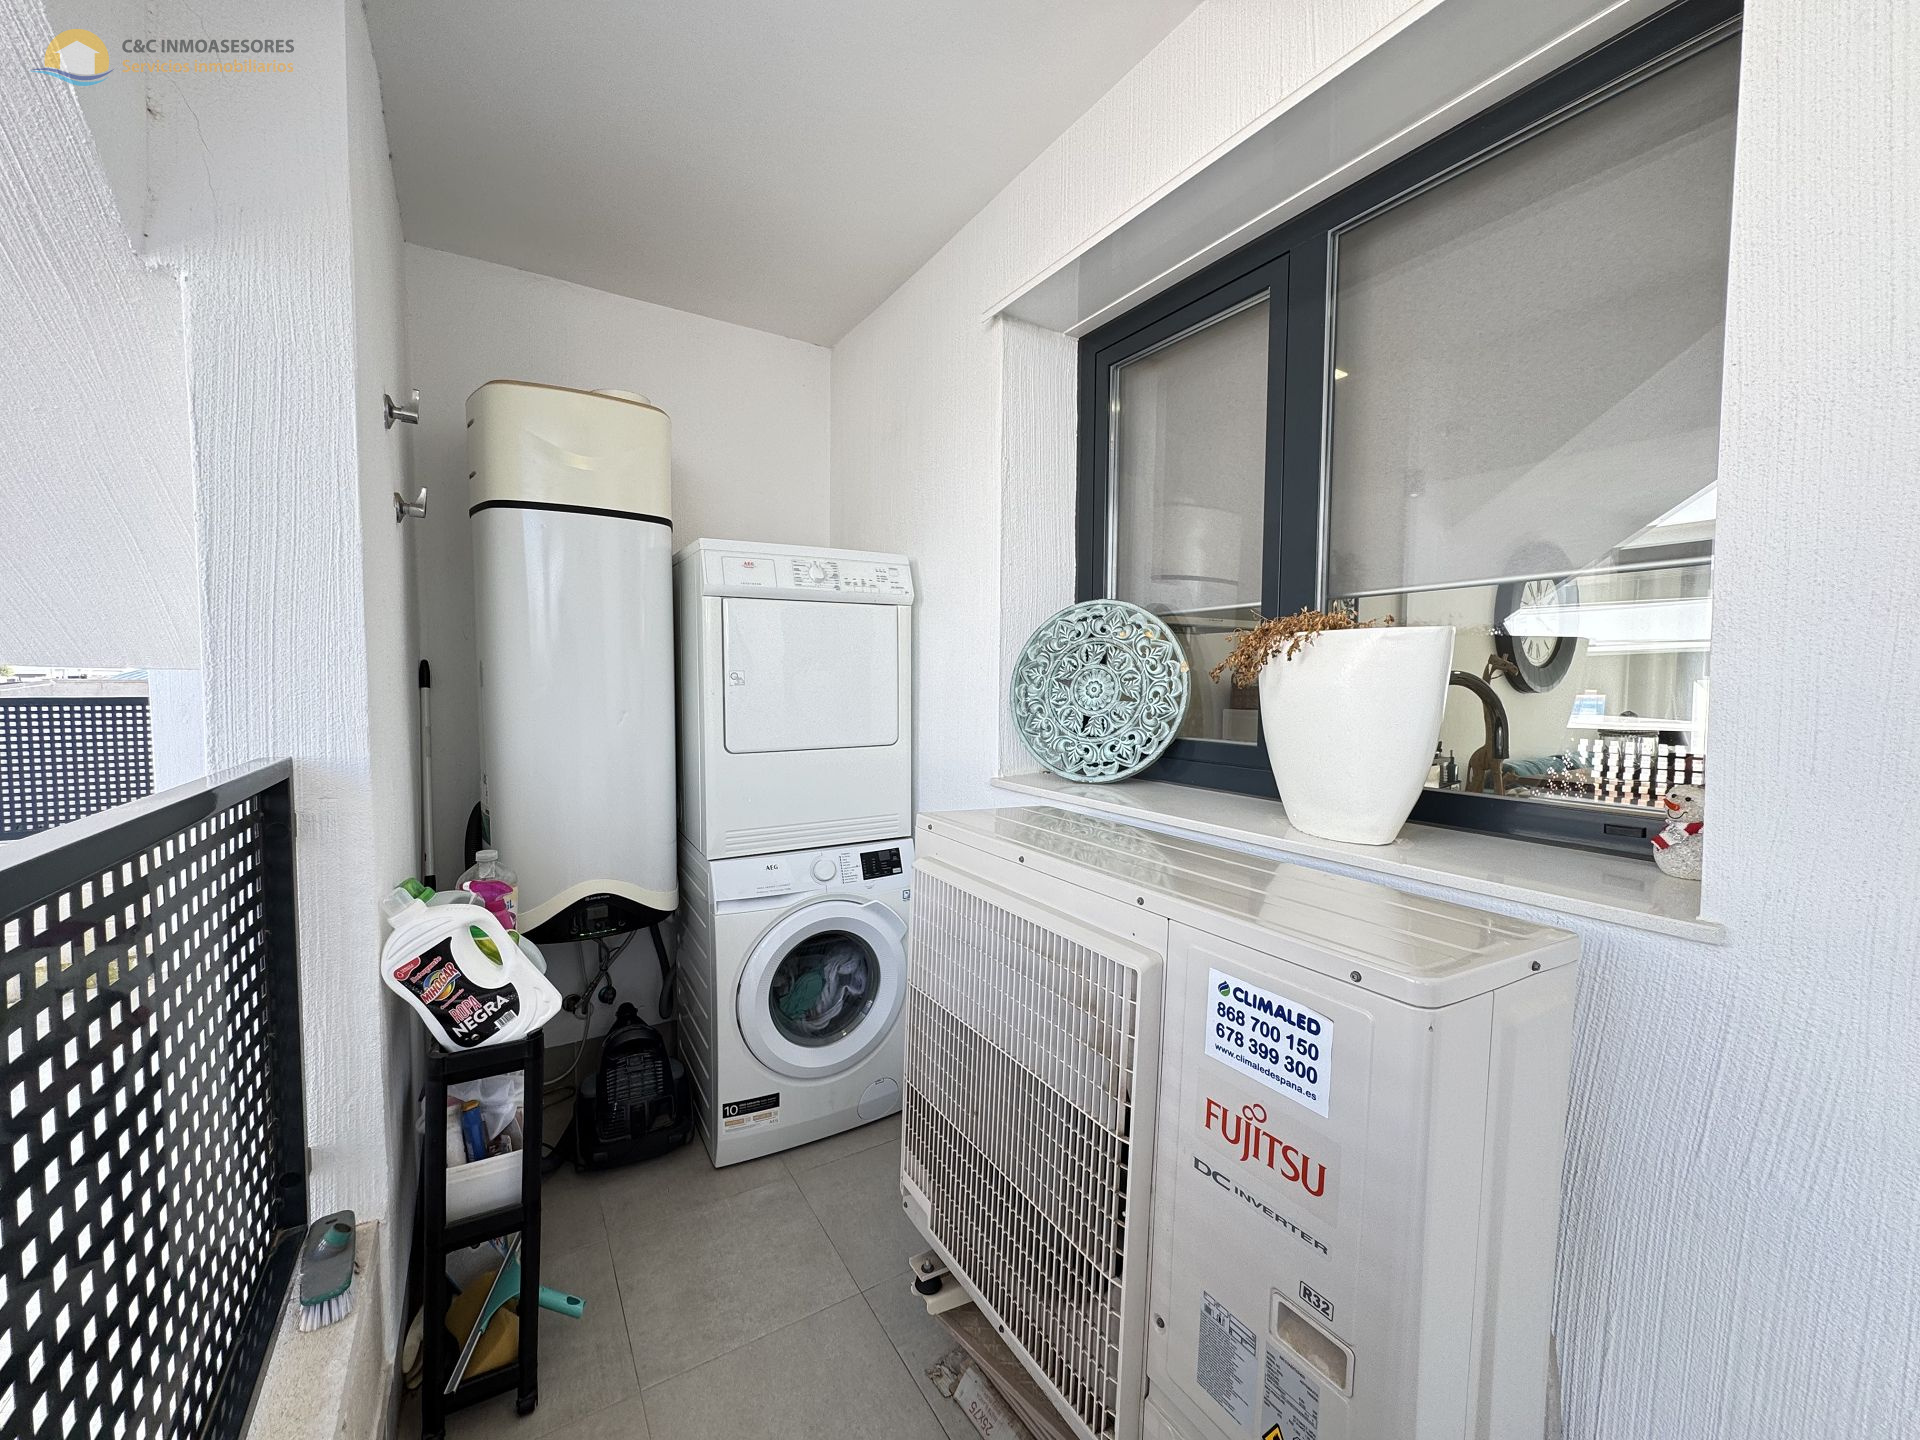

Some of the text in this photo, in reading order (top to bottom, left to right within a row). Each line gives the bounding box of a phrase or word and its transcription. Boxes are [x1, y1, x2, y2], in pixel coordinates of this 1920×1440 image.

[420, 962, 458, 1004] MIHOGAR
[449, 995, 482, 1024] ROPA
[452, 995, 509, 1037] NEGRA
[1217, 1002, 1319, 1061] 868 700 150
[1233, 987, 1321, 1036] CLIMALED
[1214, 1043, 1317, 1100] www.climaledespana.es
[1216, 1023, 1318, 1084] 678 399 300
[724, 1104, 738, 1116] 10
[1205, 1097, 1327, 1197] FUJITSU
[1193, 1155, 1328, 1255] DC INVERTER
[1302, 1285, 1330, 1317] R32
